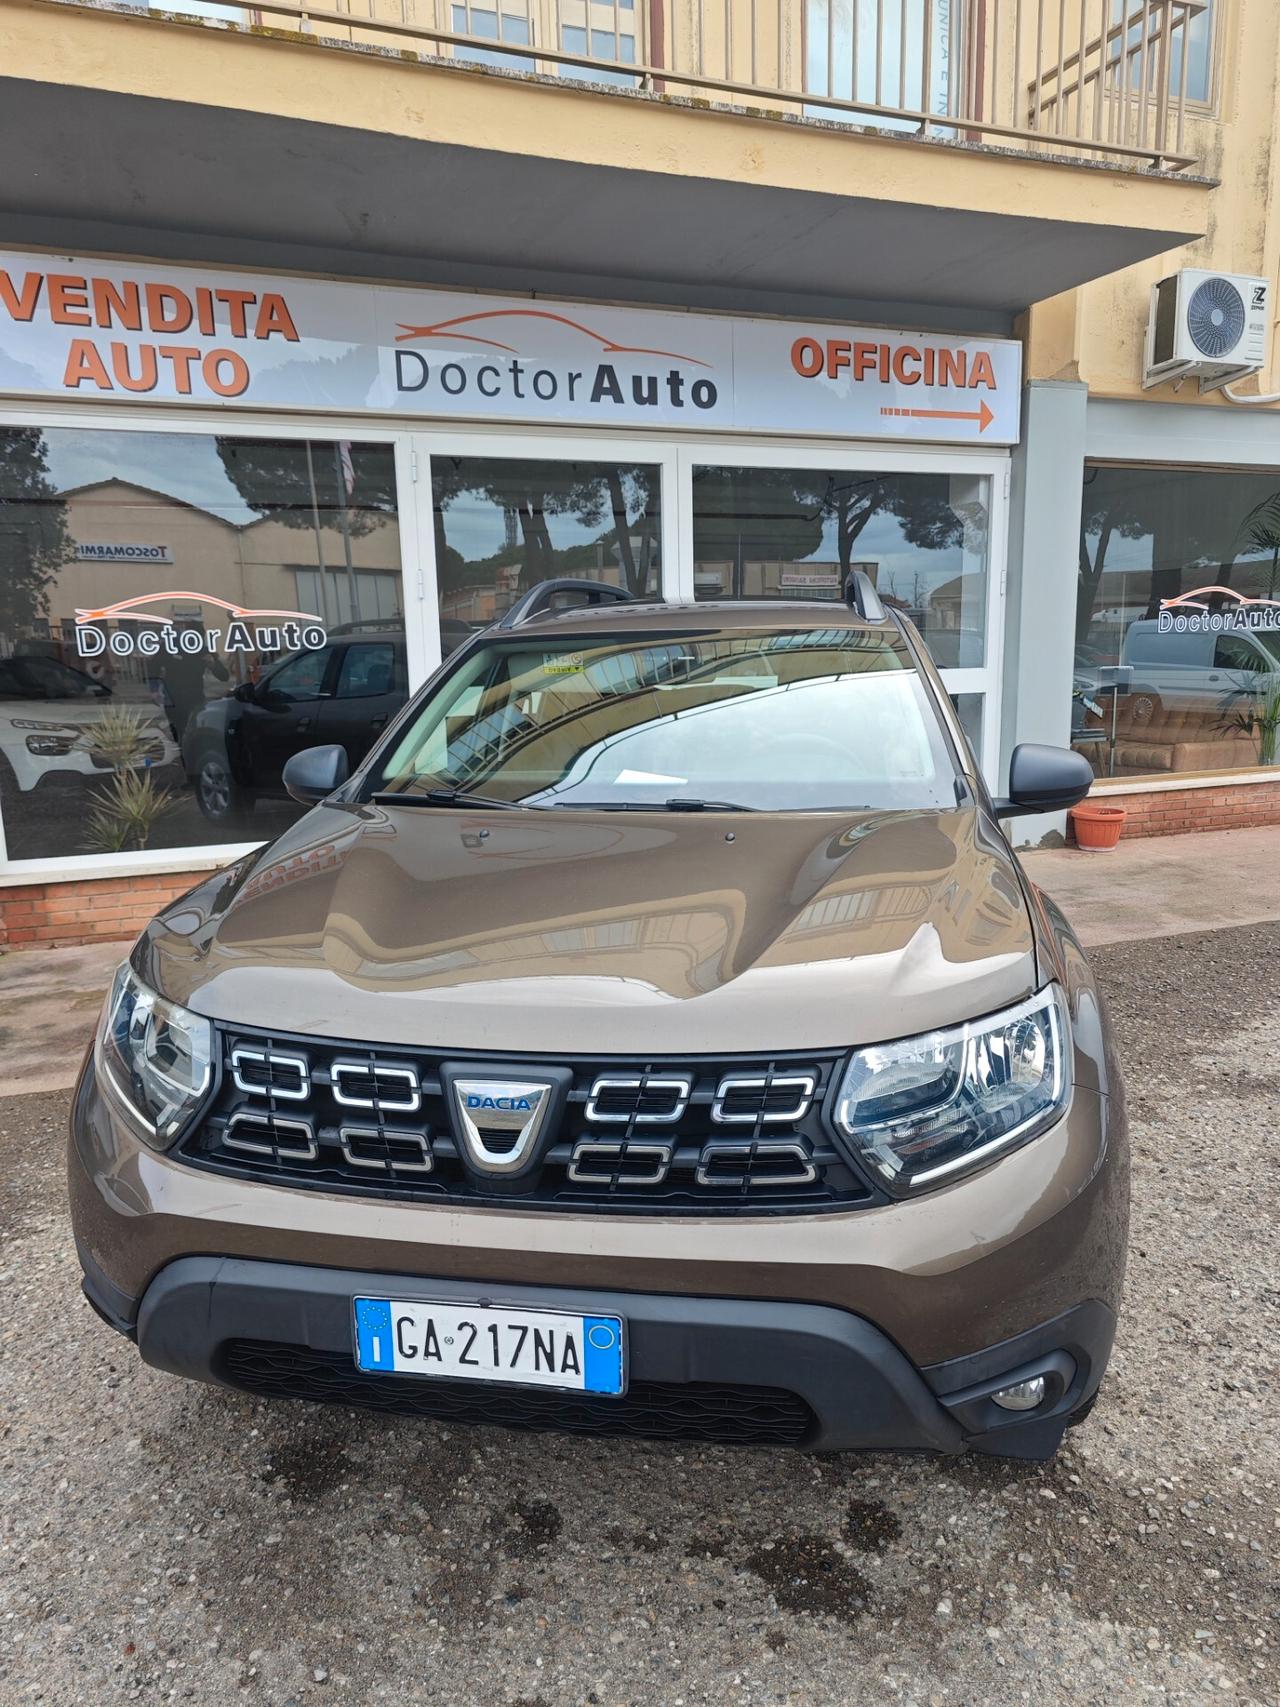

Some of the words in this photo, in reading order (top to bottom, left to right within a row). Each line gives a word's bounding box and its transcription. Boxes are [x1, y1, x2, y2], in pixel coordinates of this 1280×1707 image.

[0, 269, 300, 342] VENDITA
[63, 339, 250, 397] AUTO
[394, 350, 718, 410] DoctorAuto
[790, 336, 997, 390] OFFICINA
[75, 622, 327, 657] DoctorAuto
[467, 1096, 531, 1110] DACIA
